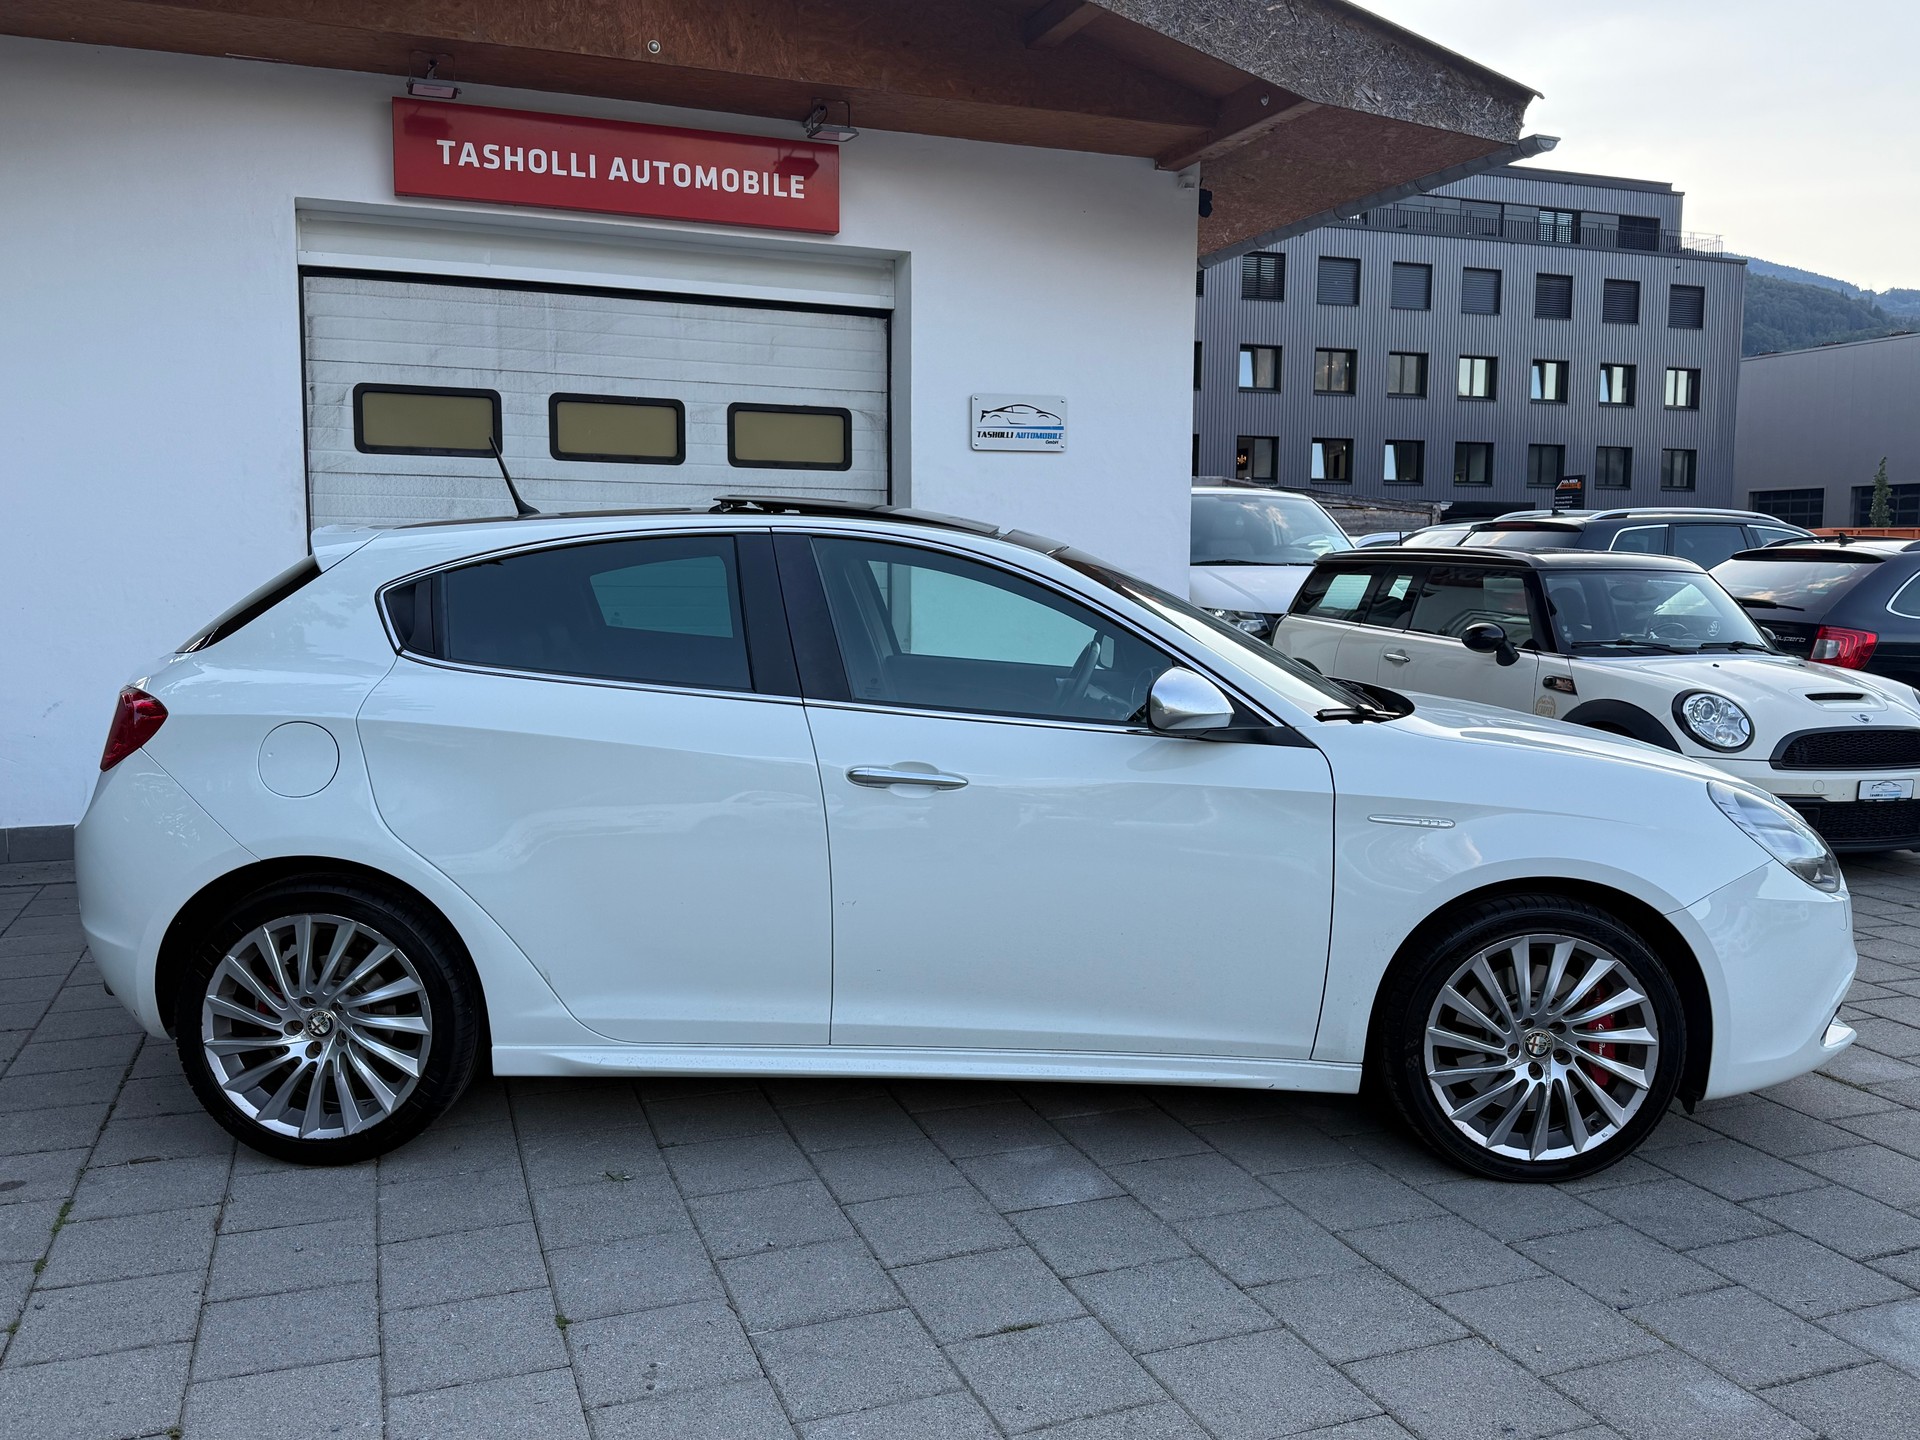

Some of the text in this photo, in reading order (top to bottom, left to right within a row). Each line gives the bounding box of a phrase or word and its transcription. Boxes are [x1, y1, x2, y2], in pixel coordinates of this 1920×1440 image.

[436, 139, 805, 199] TASHOLLI AUTOMOBILE
[977, 431, 1063, 440] TASHOLLI AUTOMOBILE
